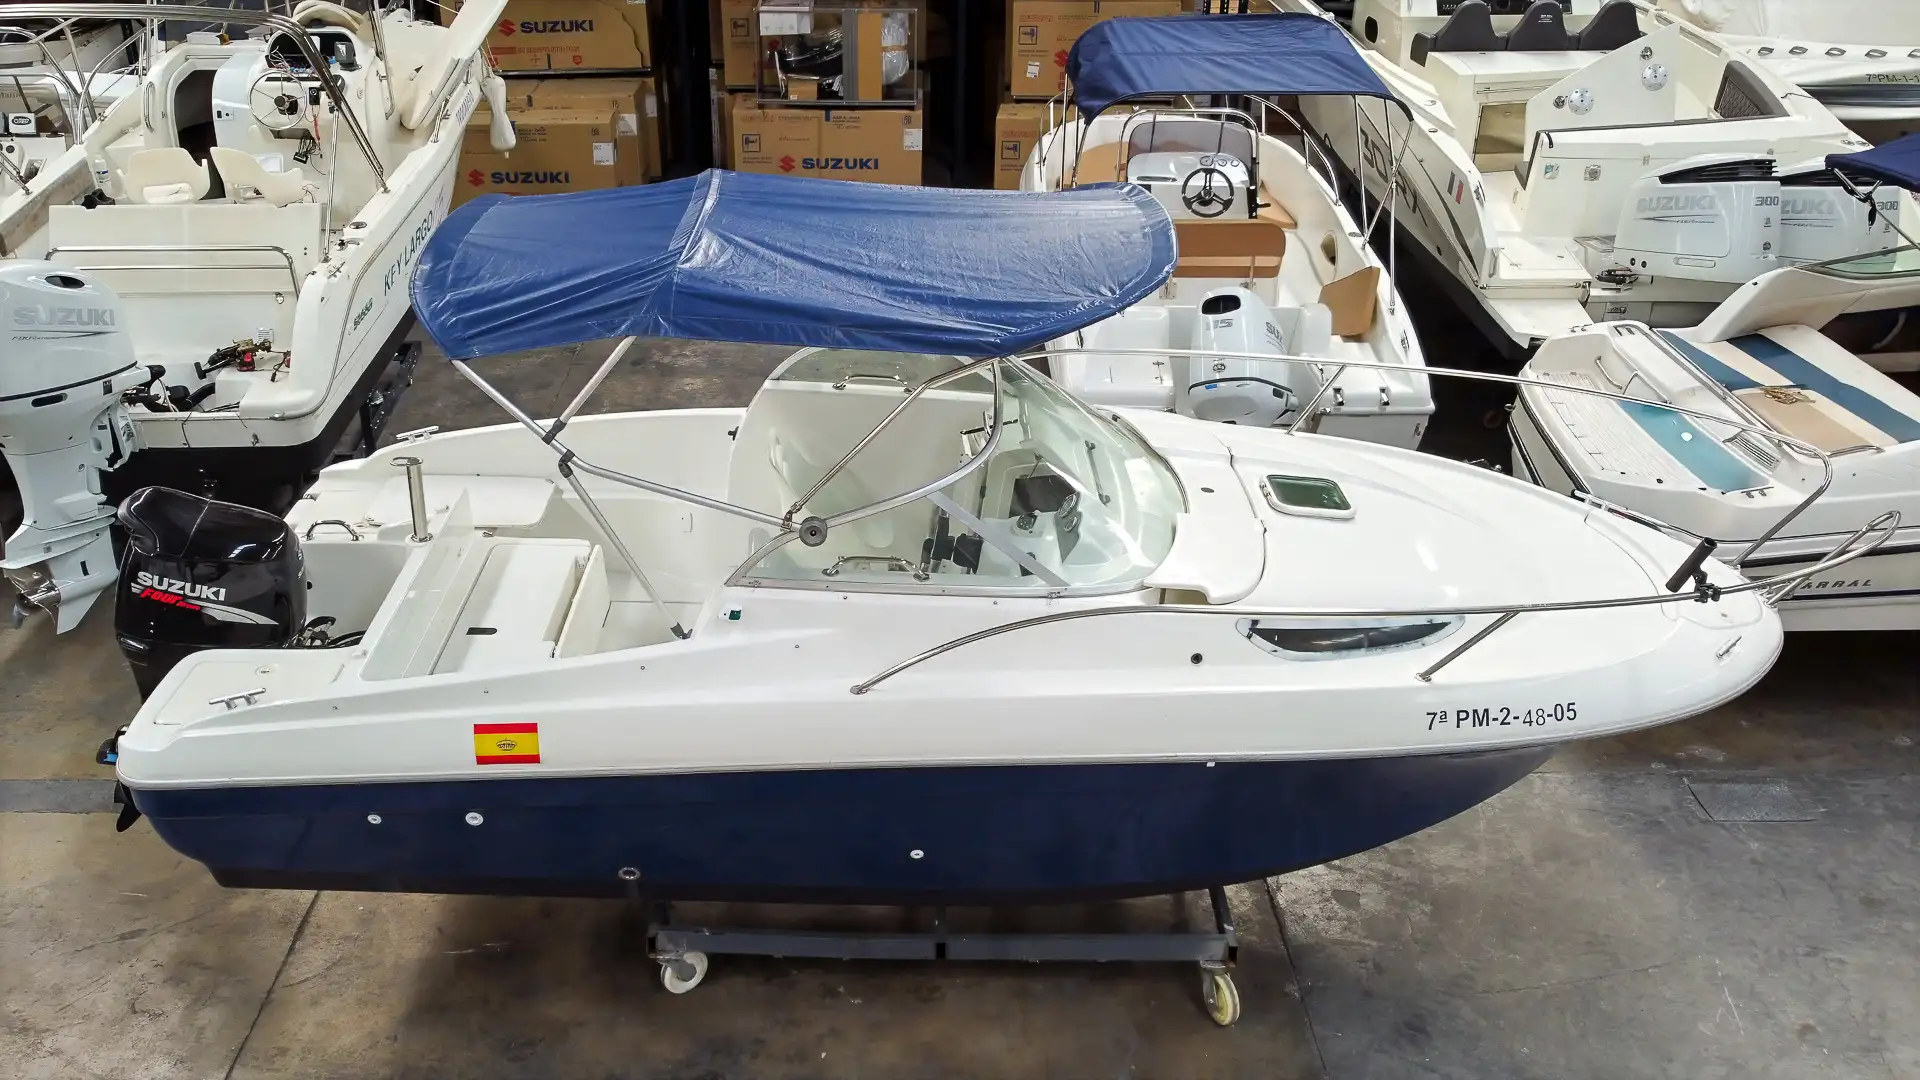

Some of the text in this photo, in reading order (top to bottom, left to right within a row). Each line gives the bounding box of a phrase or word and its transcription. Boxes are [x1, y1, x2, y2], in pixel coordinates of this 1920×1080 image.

[520, 19, 594, 34] SUZUKI
[801, 157, 879, 170] SUZUKI
[490, 171, 570, 184] SUZUKI
[1636, 194, 1717, 212] SUZUKI
[1755, 196, 1779, 207] 300
[1876, 200, 1899, 211] 300
[384, 209, 433, 296] KEY LARGO
[13, 306, 116, 327] SUZUKI
[136, 571, 227, 601] SUZUKI
[1426, 702, 1577, 731] 7ª PM-2-48-05
